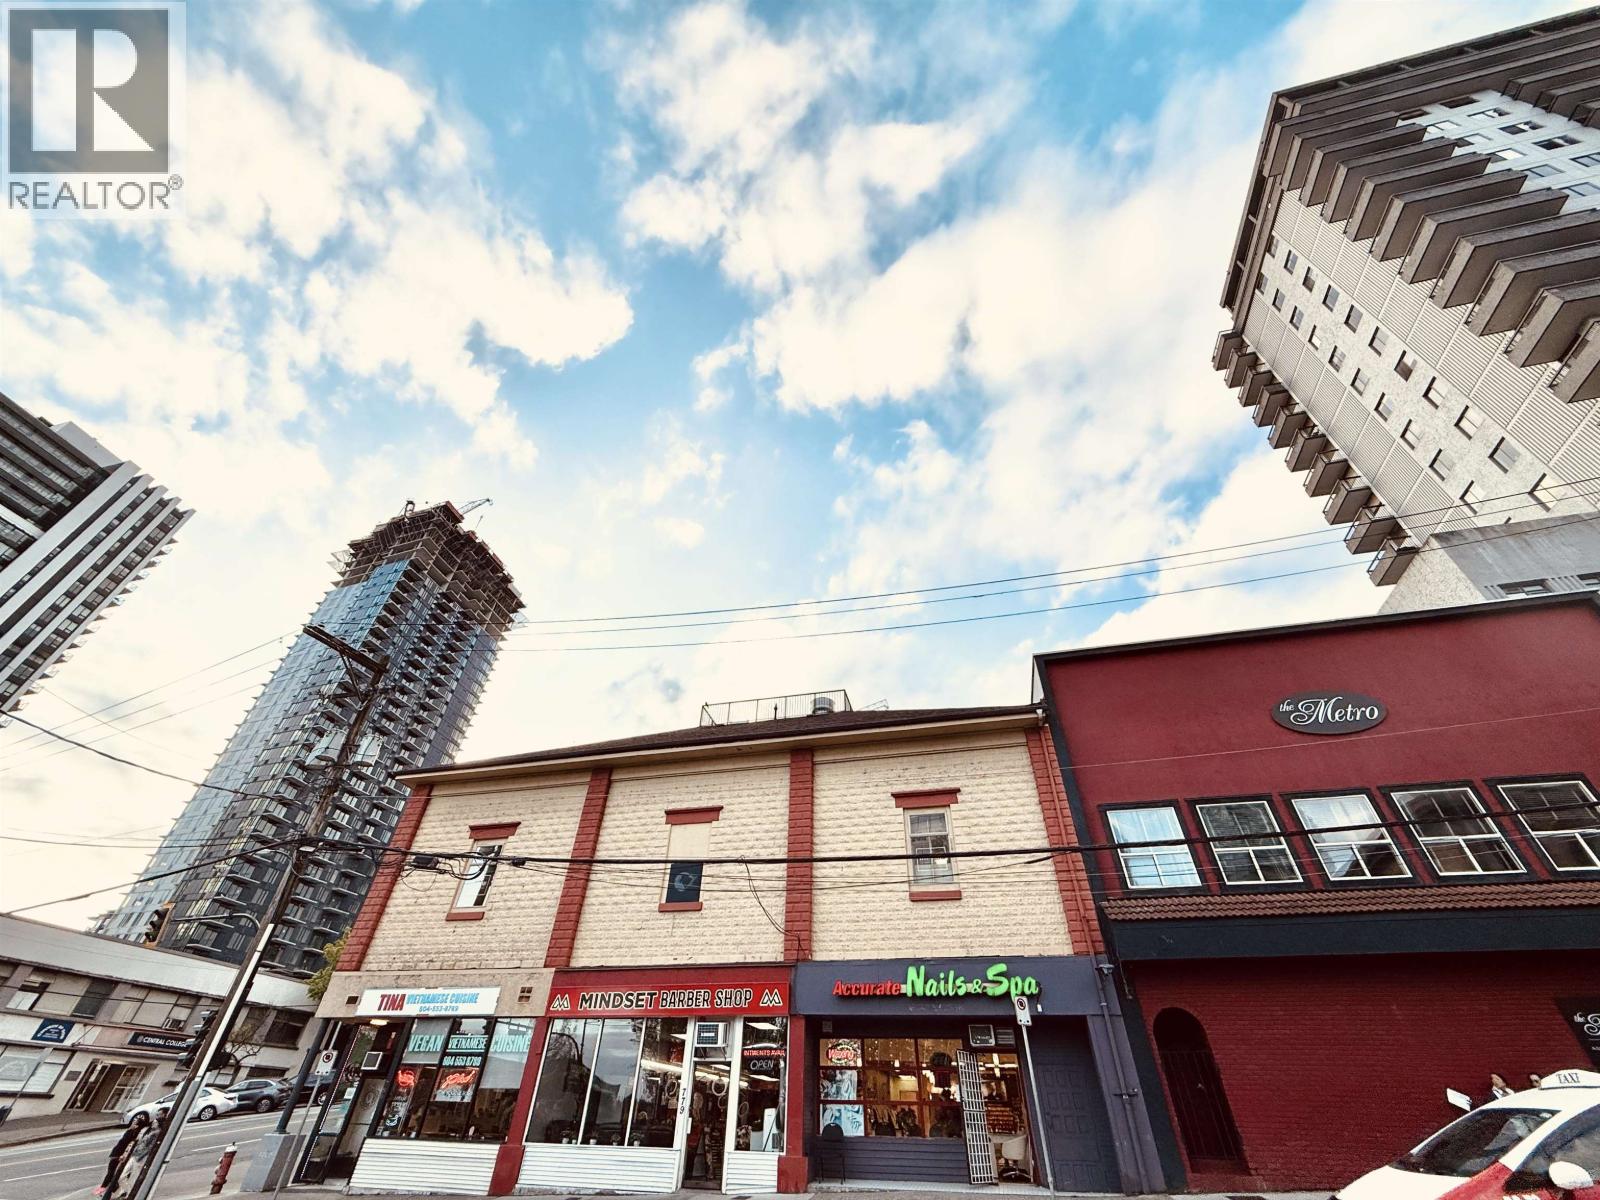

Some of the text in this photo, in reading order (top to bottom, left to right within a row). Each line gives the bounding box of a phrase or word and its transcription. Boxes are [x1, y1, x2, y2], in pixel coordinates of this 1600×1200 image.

[1279, 696, 1379, 725] the Metro
[832, 962, 1039, 1003] Accurate Nails & Spa
[377, 992, 480, 1011] TINA VIETNAMESE CUISINE
[578, 991, 658, 1011] MINDSET
[659, 989, 711, 1009] BARBER
[715, 988, 753, 1008] SHOP
[143, 1036, 165, 1045] CENTRAL
[408, 1034, 530, 1053] VEGAN VIETNAMESE CUISINE
[750, 1059, 775, 1070] OPEN
[1556, 1072, 1580, 1084] TAXI
[679, 1088, 687, 1115] 779
